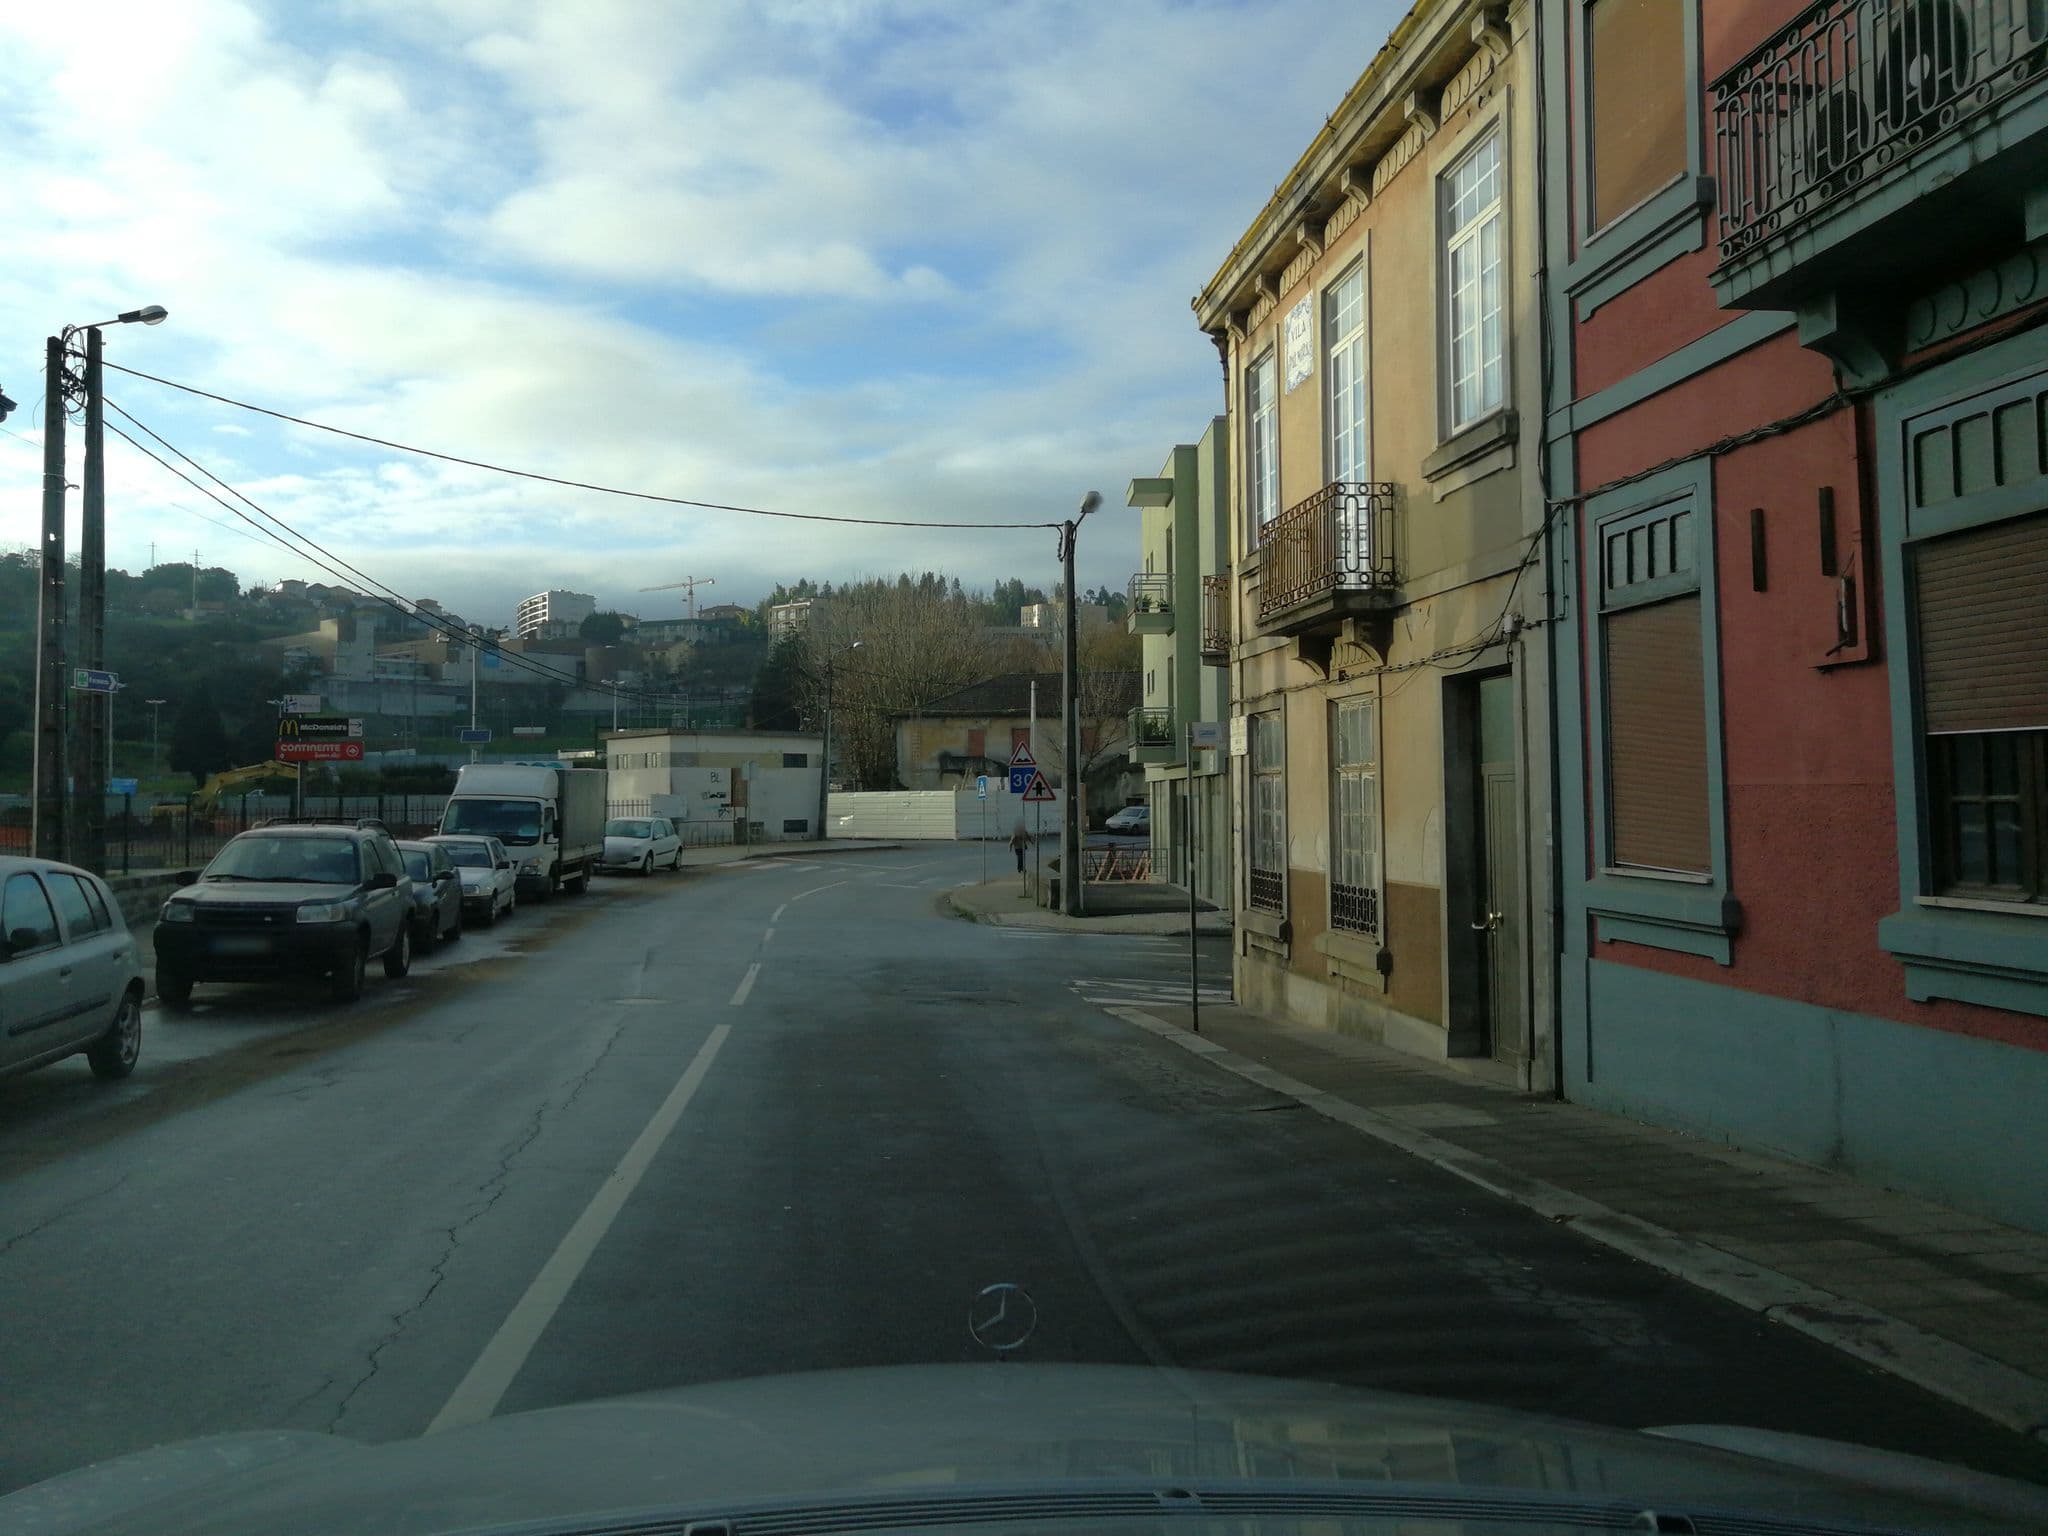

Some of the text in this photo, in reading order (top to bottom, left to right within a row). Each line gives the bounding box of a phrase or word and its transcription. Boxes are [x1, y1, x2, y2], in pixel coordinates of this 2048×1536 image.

[300, 724, 347, 732] McDonald's
[280, 743, 341, 752] CONTINENTE
[1013, 773, 1034, 787] 30
